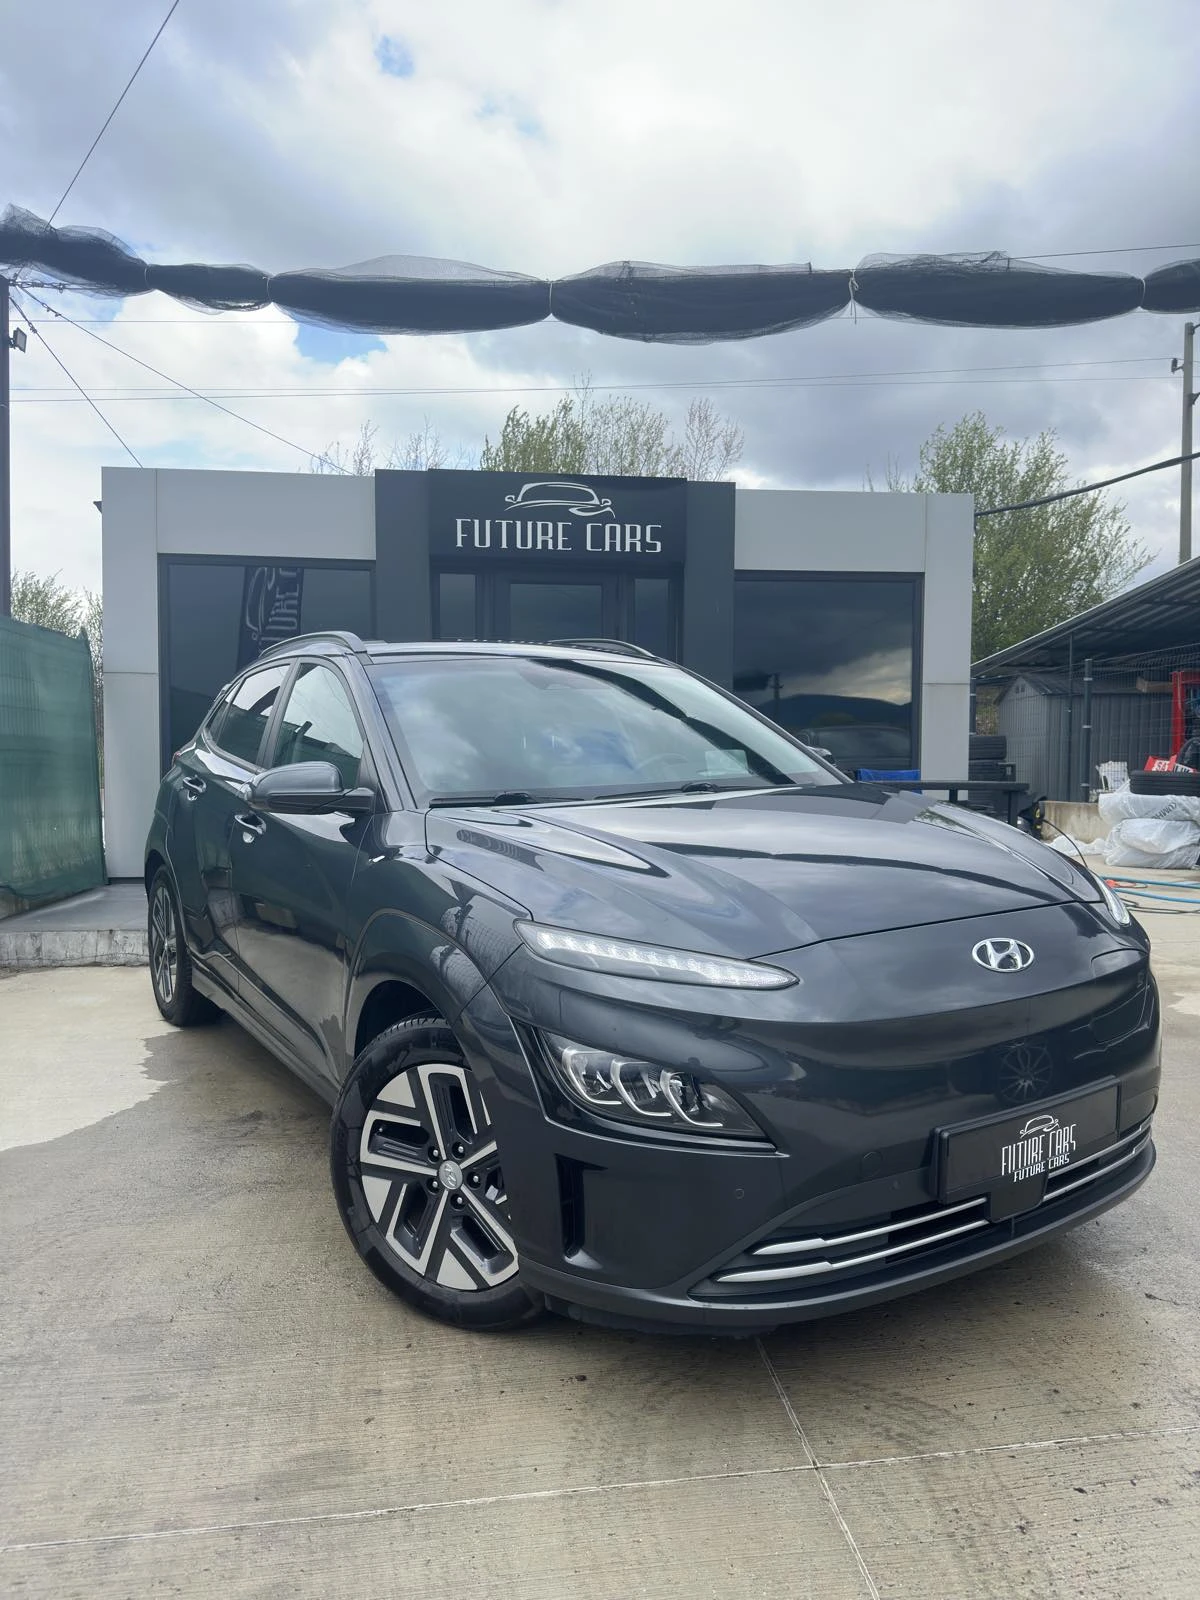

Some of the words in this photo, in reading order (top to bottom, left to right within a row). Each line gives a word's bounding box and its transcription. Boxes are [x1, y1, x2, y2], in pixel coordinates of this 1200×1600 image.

[455, 518, 572, 550] FUTURE
[586, 523, 662, 553] CARS
[1002, 1135, 1045, 1176] FUTURE
[1048, 1124, 1077, 1158] CARS
[1013, 1162, 1046, 1182] FUTURE
[1048, 1153, 1070, 1169] CARS
